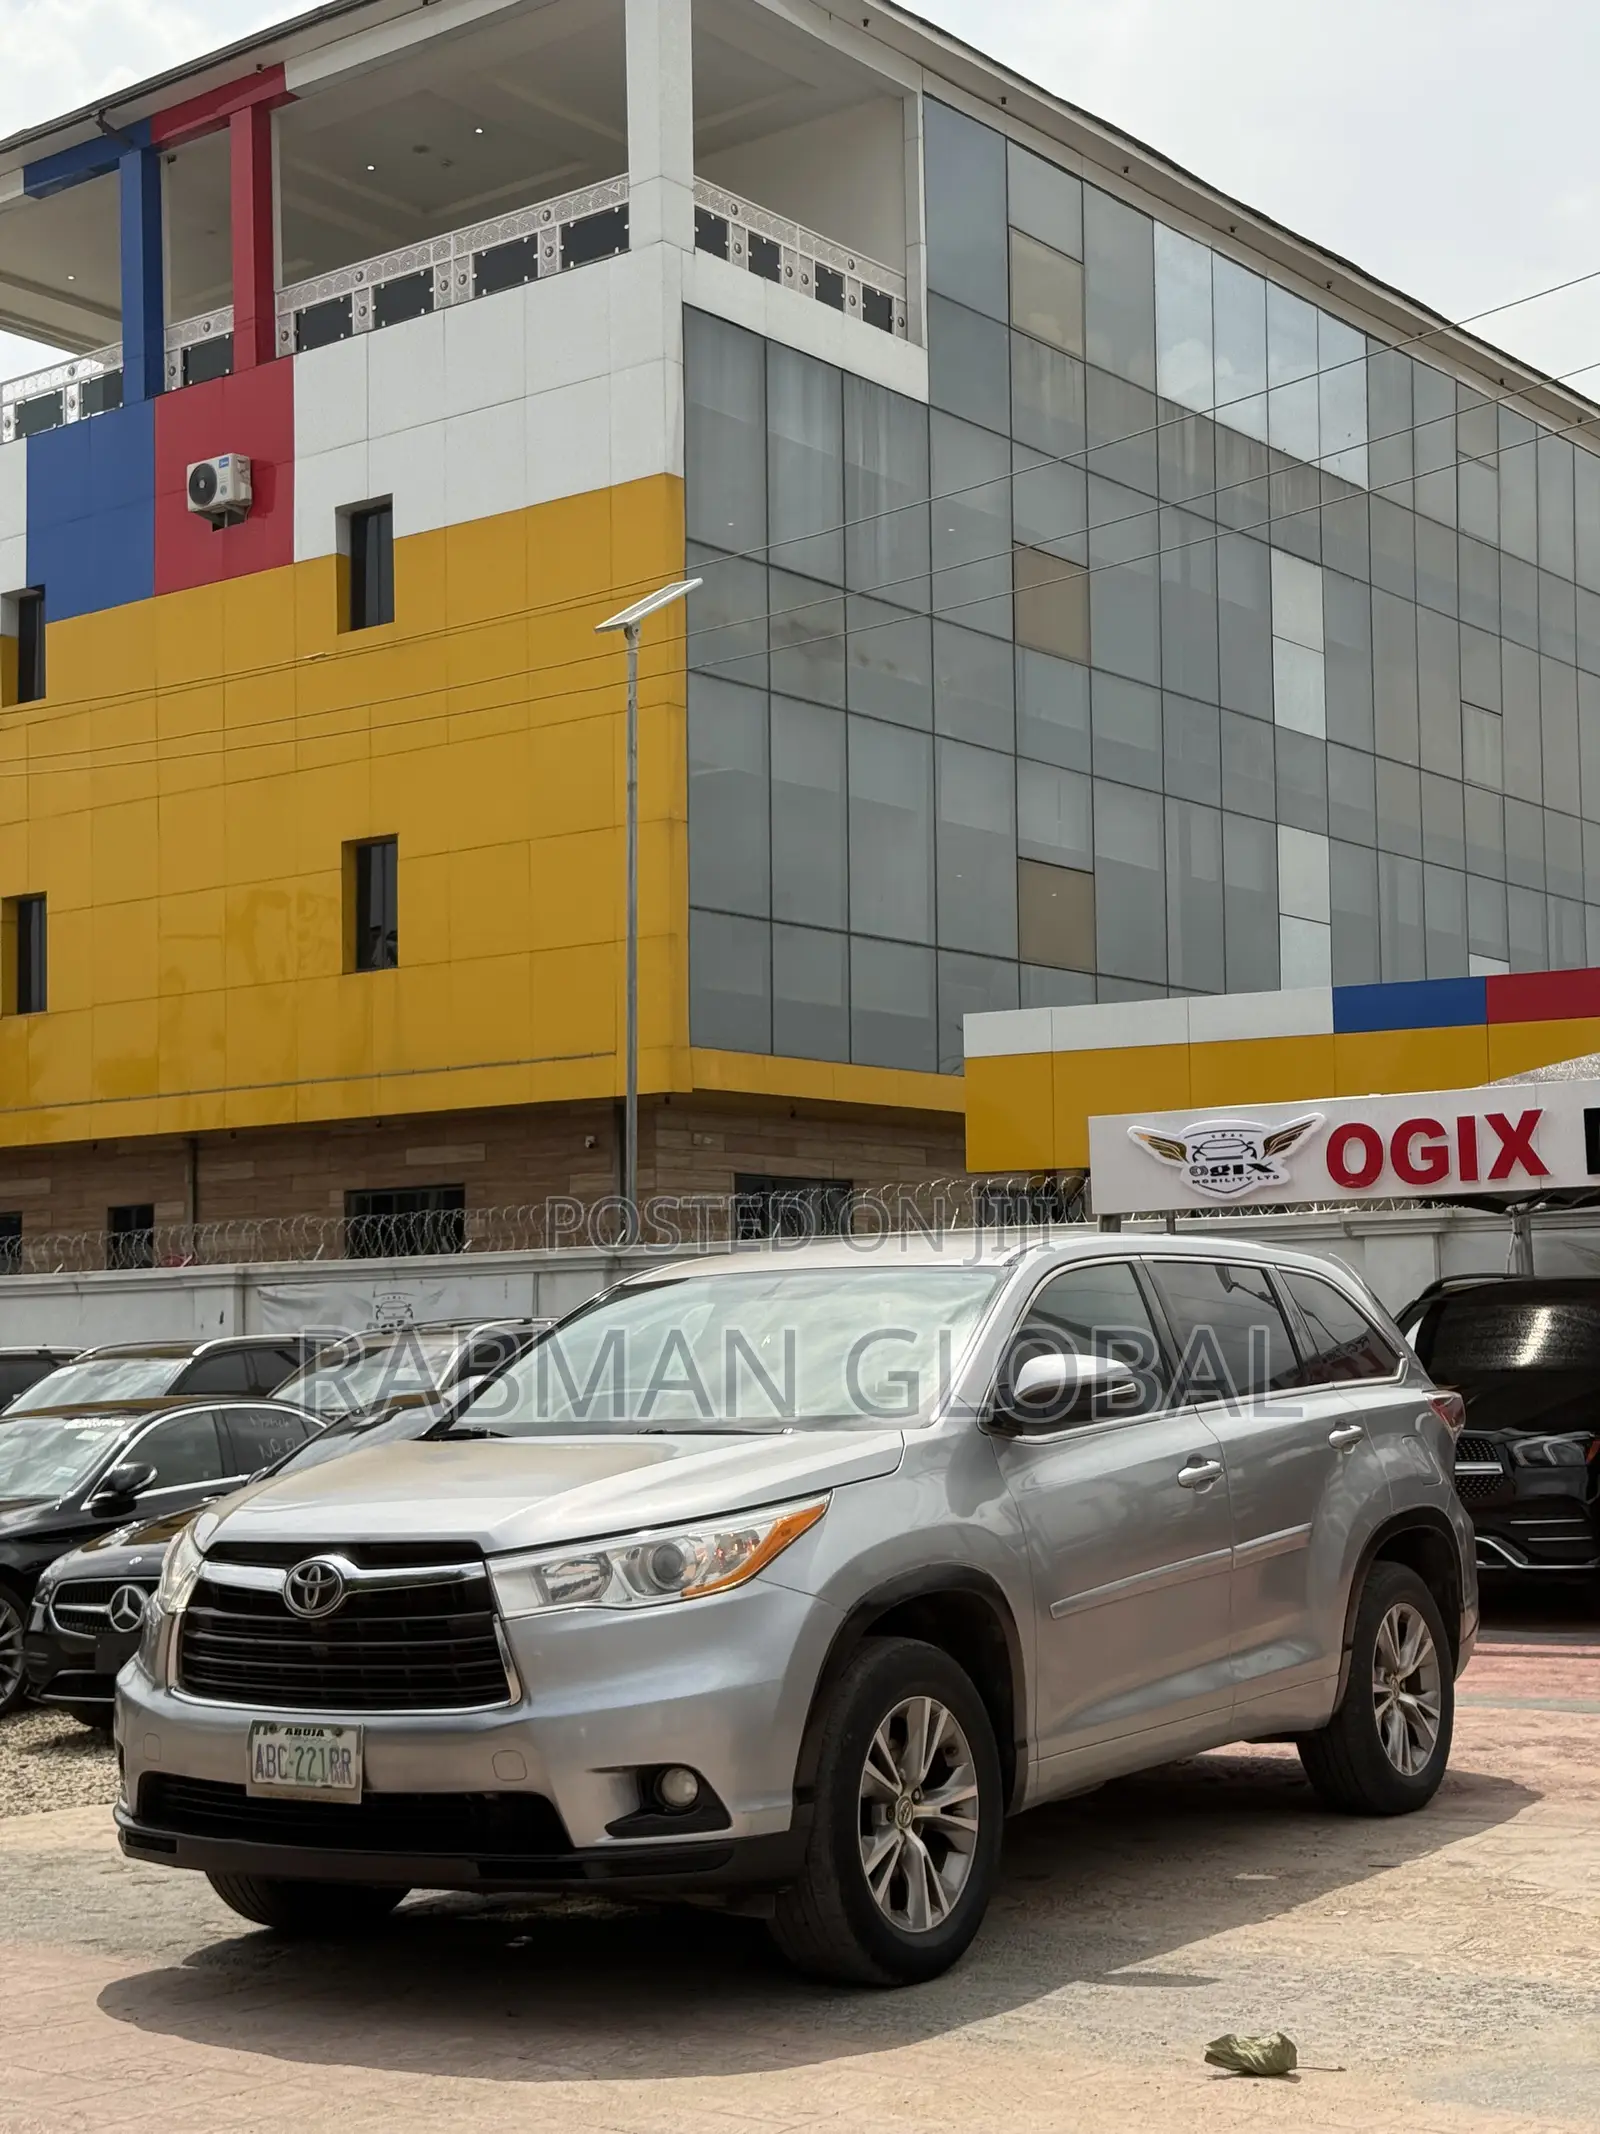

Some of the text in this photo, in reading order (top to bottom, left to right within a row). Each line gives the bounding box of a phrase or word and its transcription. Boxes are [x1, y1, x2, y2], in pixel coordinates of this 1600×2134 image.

[1326, 1108, 1551, 1189] OGIX
[1192, 1175, 1252, 1185] MOBILITY
[284, 1727, 325, 1737] ABUJA
